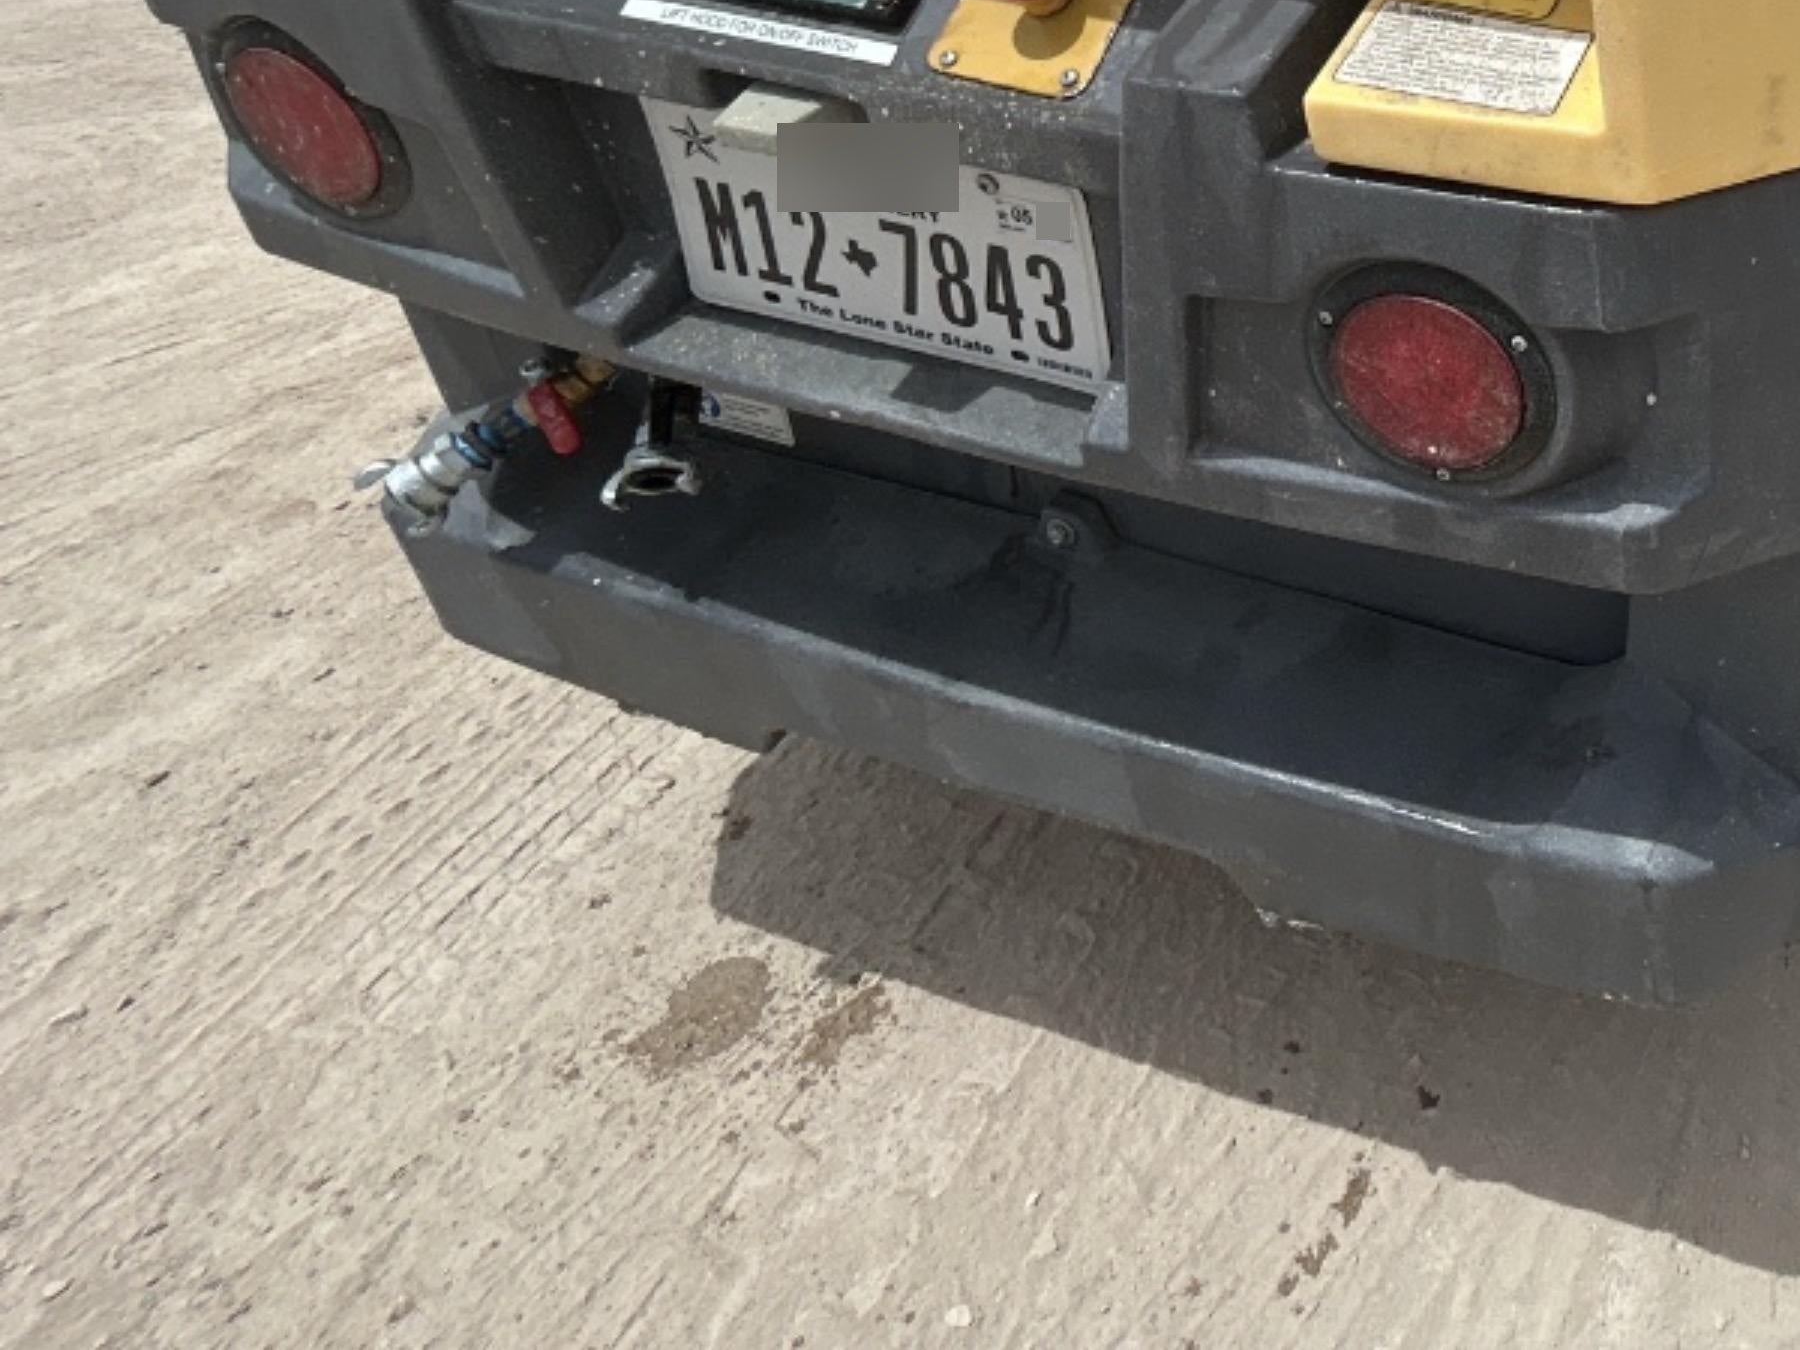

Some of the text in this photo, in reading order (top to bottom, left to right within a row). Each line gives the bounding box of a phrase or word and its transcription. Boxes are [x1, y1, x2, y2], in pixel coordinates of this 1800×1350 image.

[796, 298, 995, 355] The Lone Star State
[878, 217, 1075, 351] 7843
